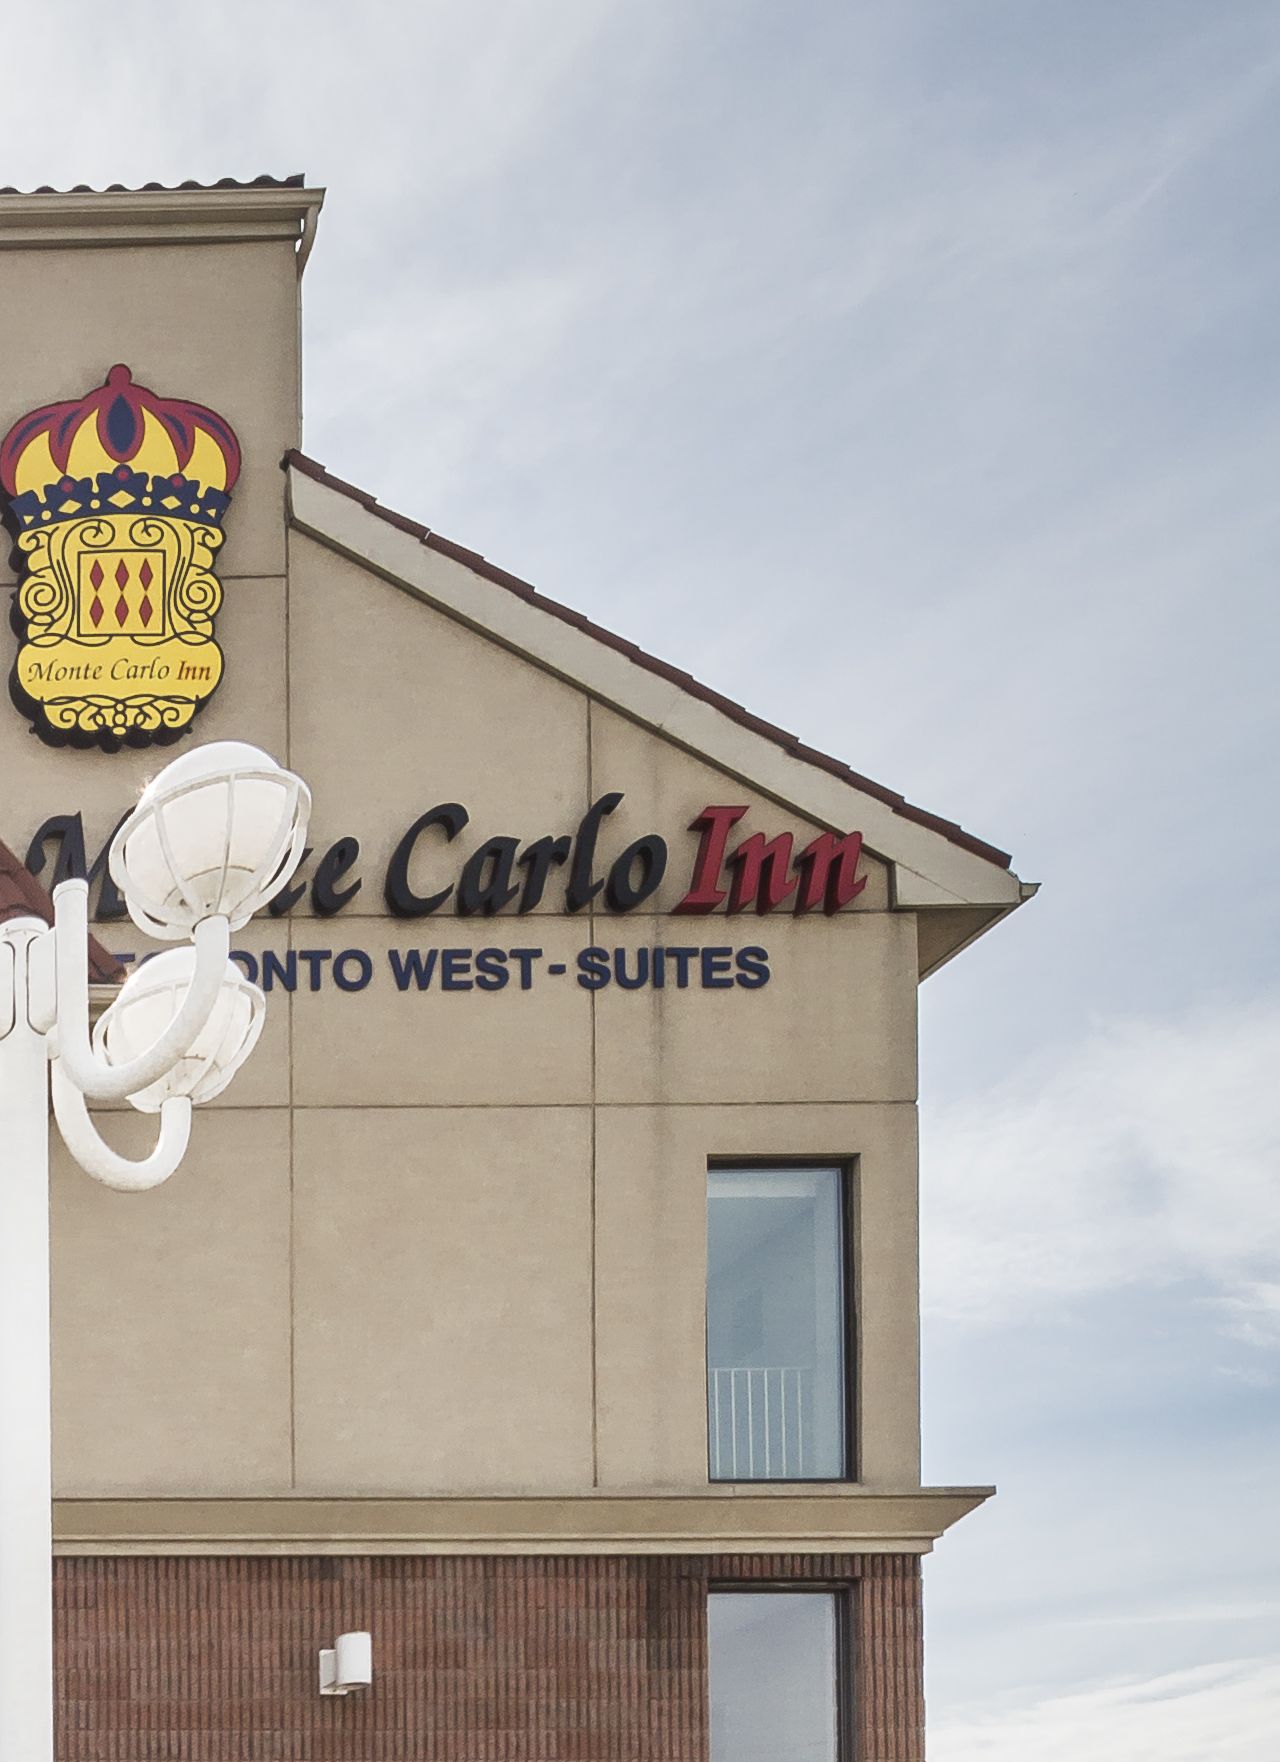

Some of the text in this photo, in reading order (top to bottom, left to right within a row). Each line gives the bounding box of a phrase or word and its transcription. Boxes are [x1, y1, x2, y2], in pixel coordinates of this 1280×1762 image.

[27, 656, 212, 683] Monte Carlo Inn
[384, 792, 669, 919] Carlo
[670, 804, 869, 918] Inn
